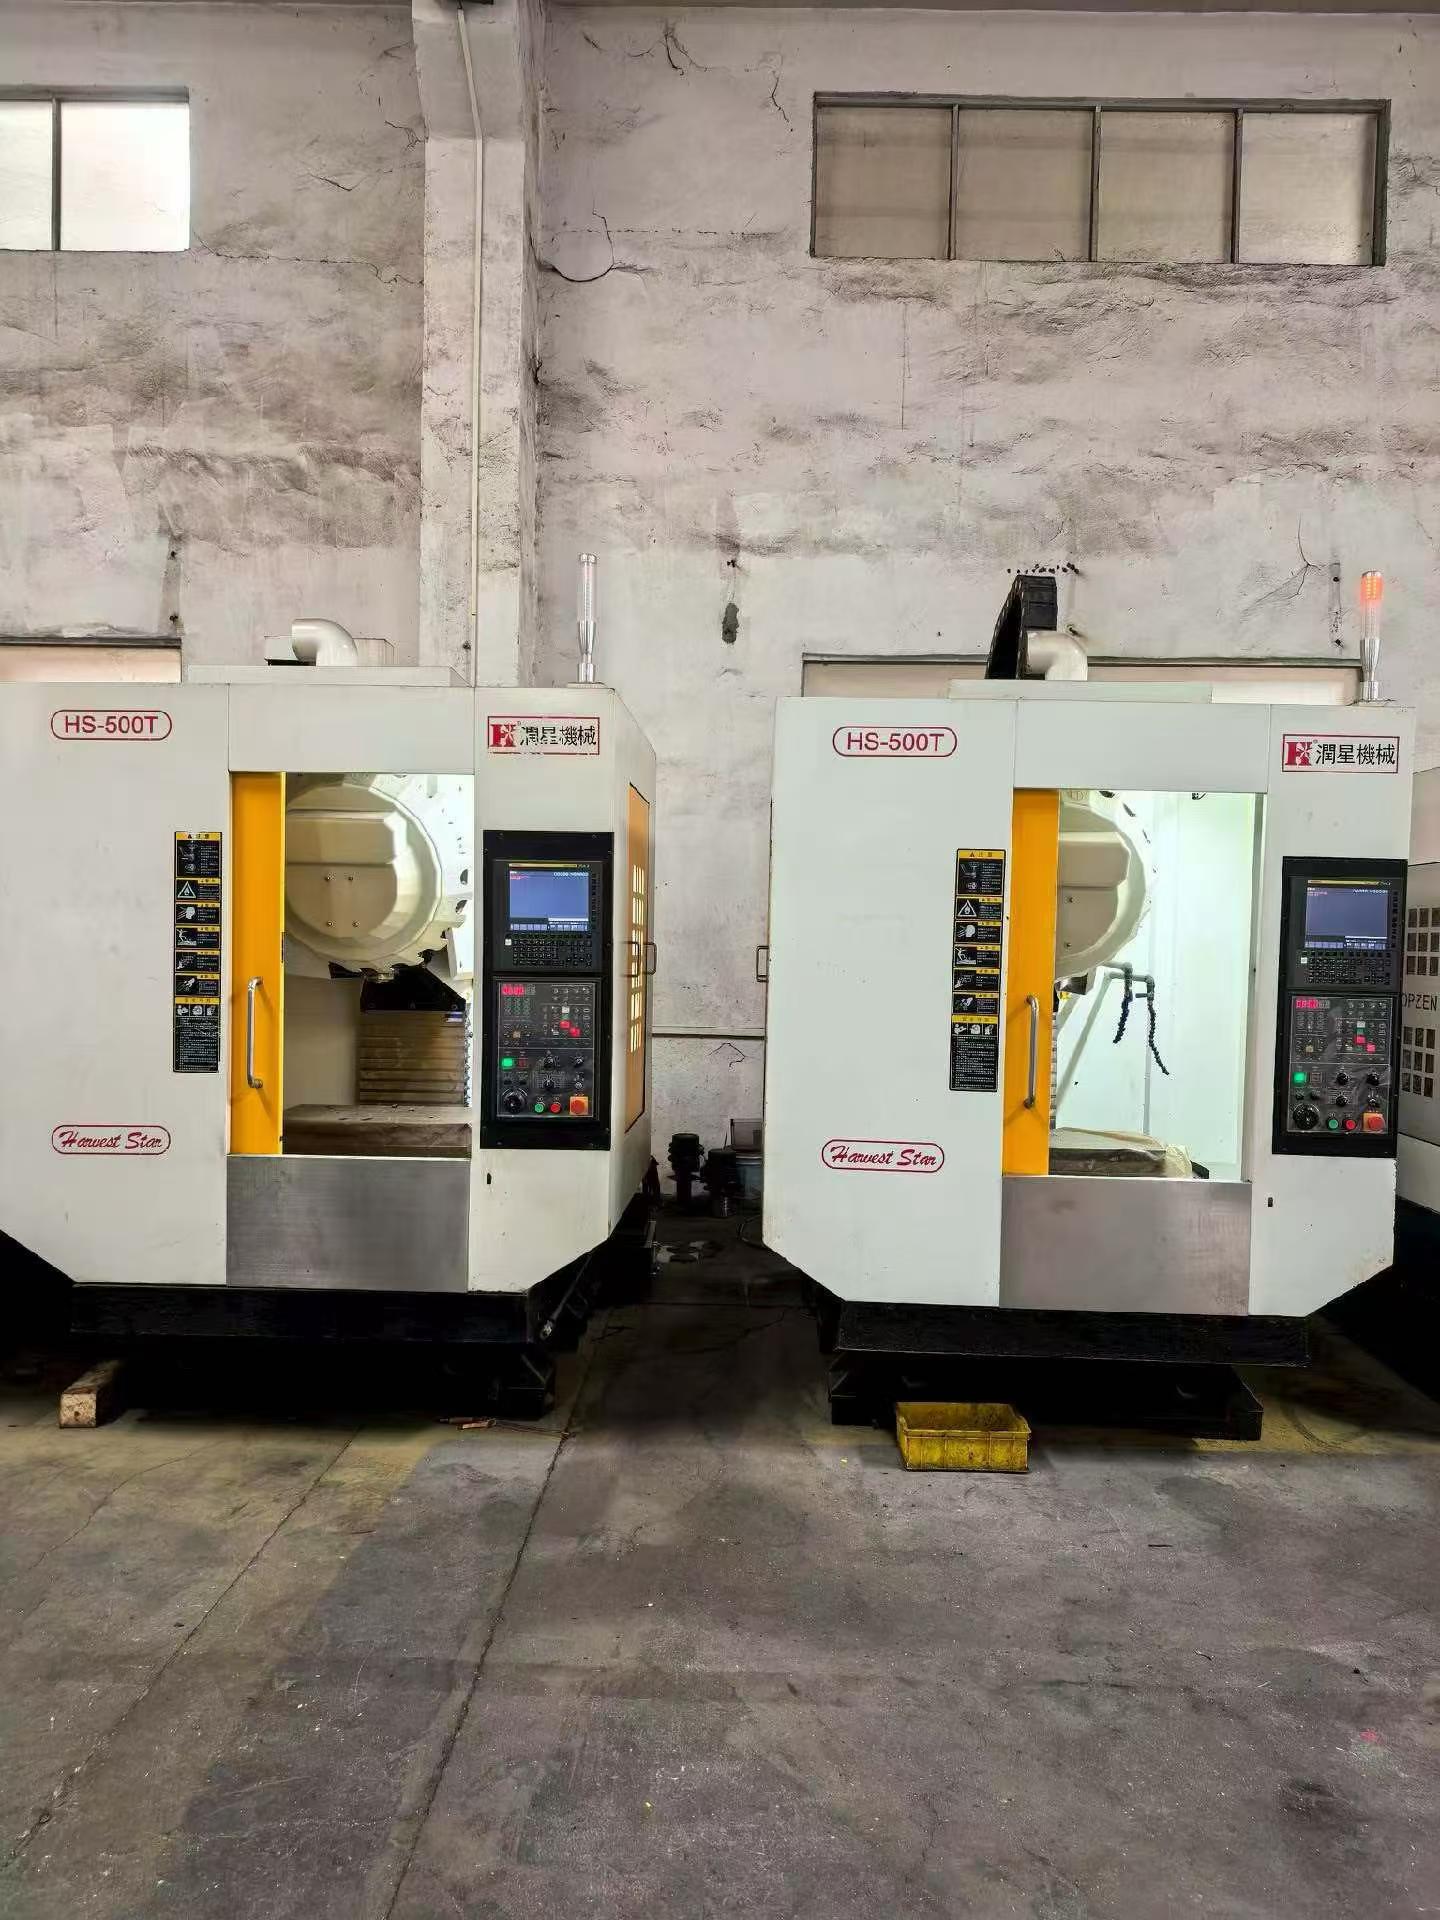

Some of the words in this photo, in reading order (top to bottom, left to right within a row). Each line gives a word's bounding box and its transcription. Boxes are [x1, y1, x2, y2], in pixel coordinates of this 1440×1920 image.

[65, 715, 158, 734] HS-500T
[520, 725, 597, 746] 潤星機械
[847, 732, 944, 752] HS-500T
[1315, 743, 1396, 766] 潤星機械
[59, 1130, 122, 1148] Harvest
[125, 1129, 162, 1149] Star
[830, 1145, 894, 1165] Harvest
[896, 1148, 937, 1166] Star
